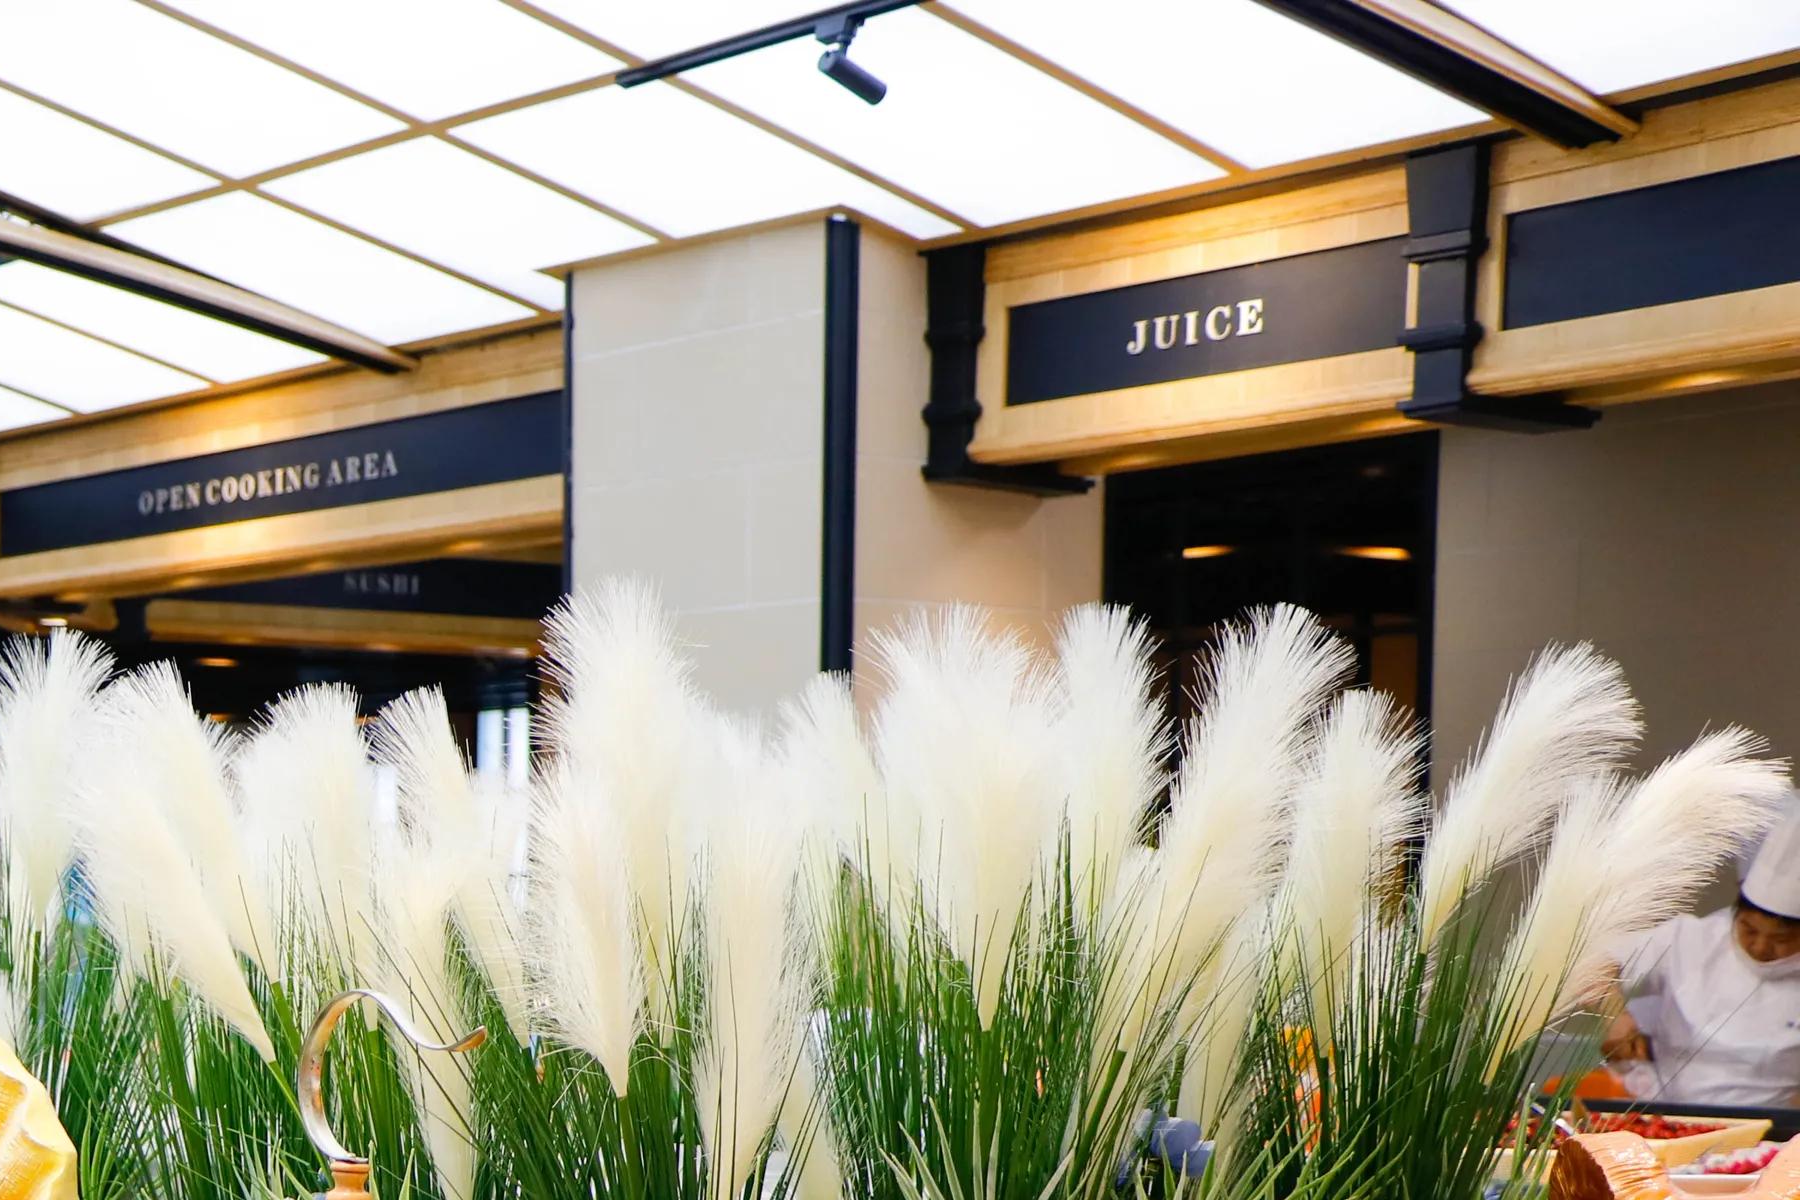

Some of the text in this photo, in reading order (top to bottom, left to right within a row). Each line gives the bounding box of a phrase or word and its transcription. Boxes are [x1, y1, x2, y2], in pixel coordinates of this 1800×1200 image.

[1126, 298, 1264, 355] JUICE
[138, 450, 399, 515] OPEN COOKING AREA
[343, 572, 419, 595] SUSHI
